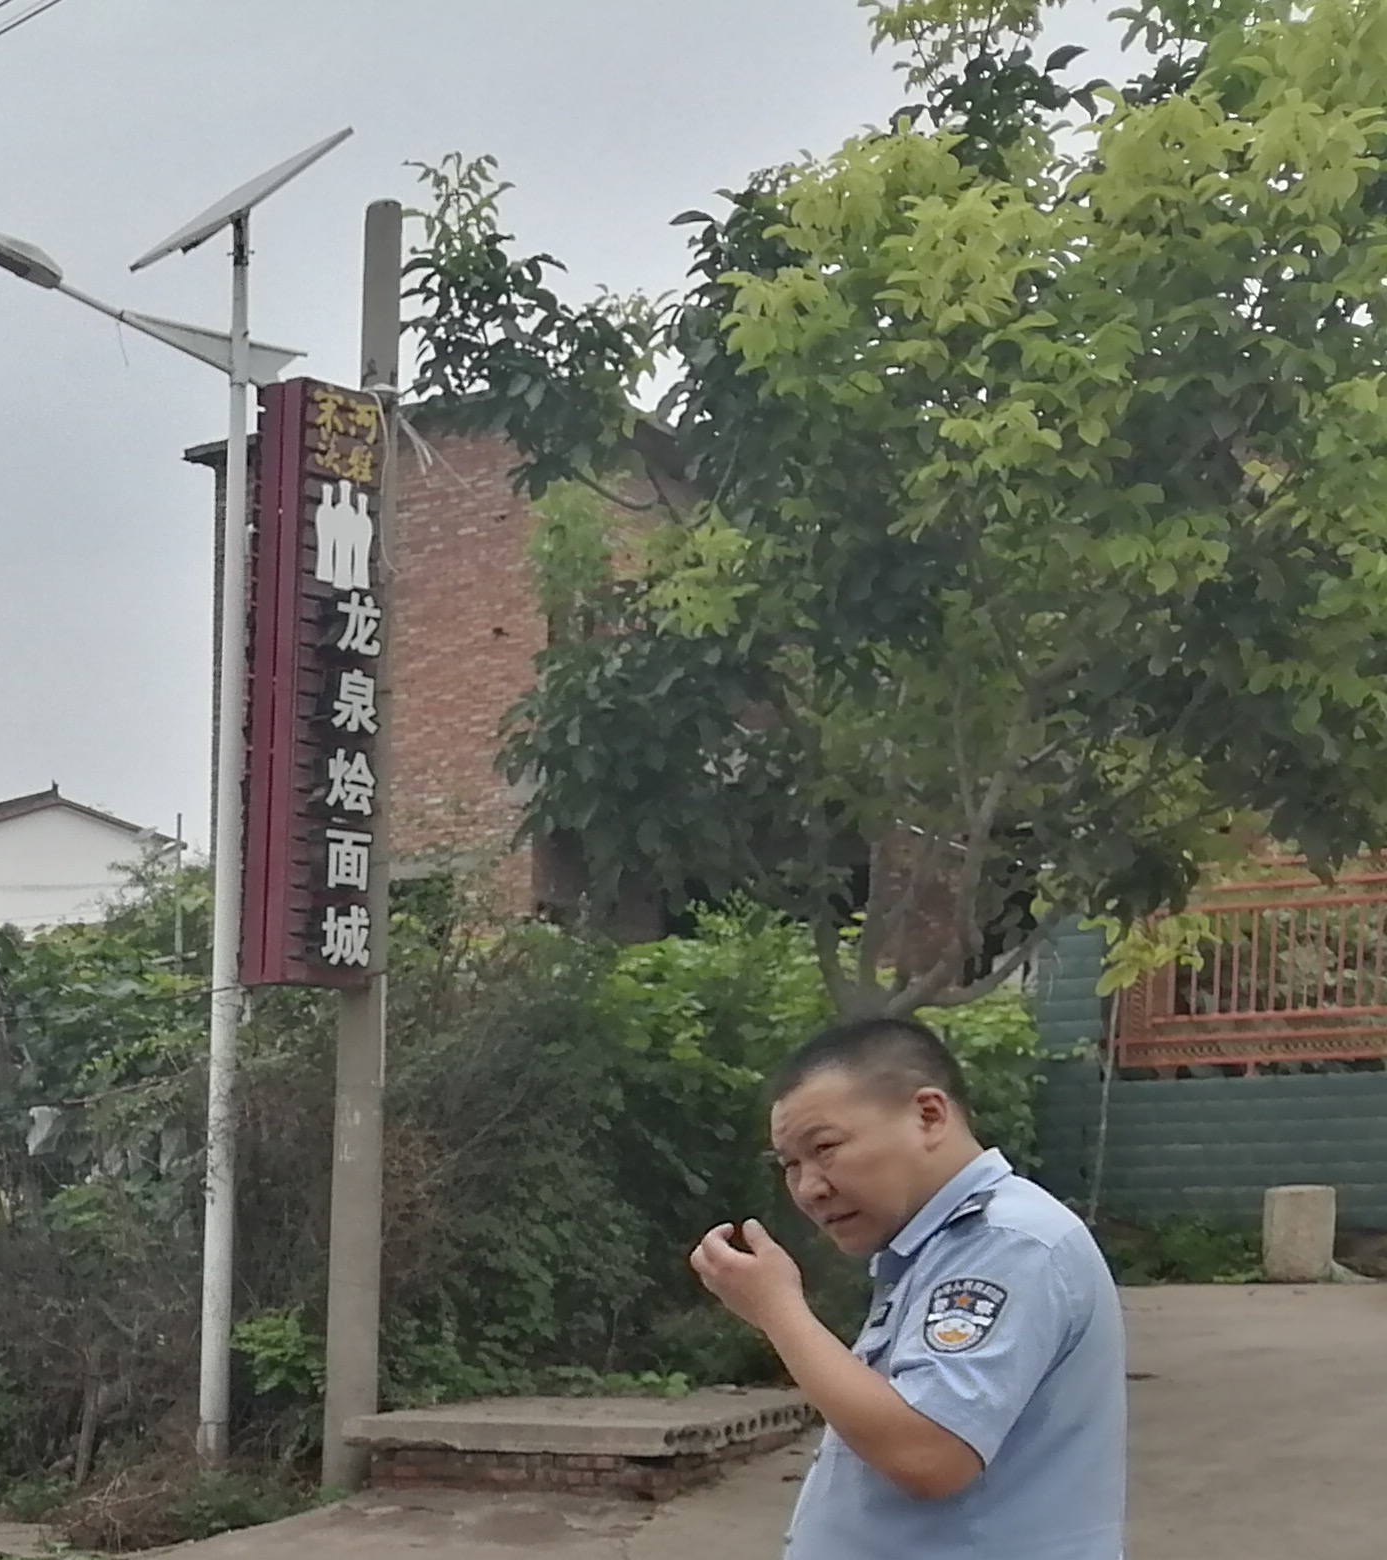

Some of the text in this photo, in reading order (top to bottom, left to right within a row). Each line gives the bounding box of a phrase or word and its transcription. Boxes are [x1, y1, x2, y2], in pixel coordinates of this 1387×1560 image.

[321, 591, 382, 969] 龙泉烩面城
